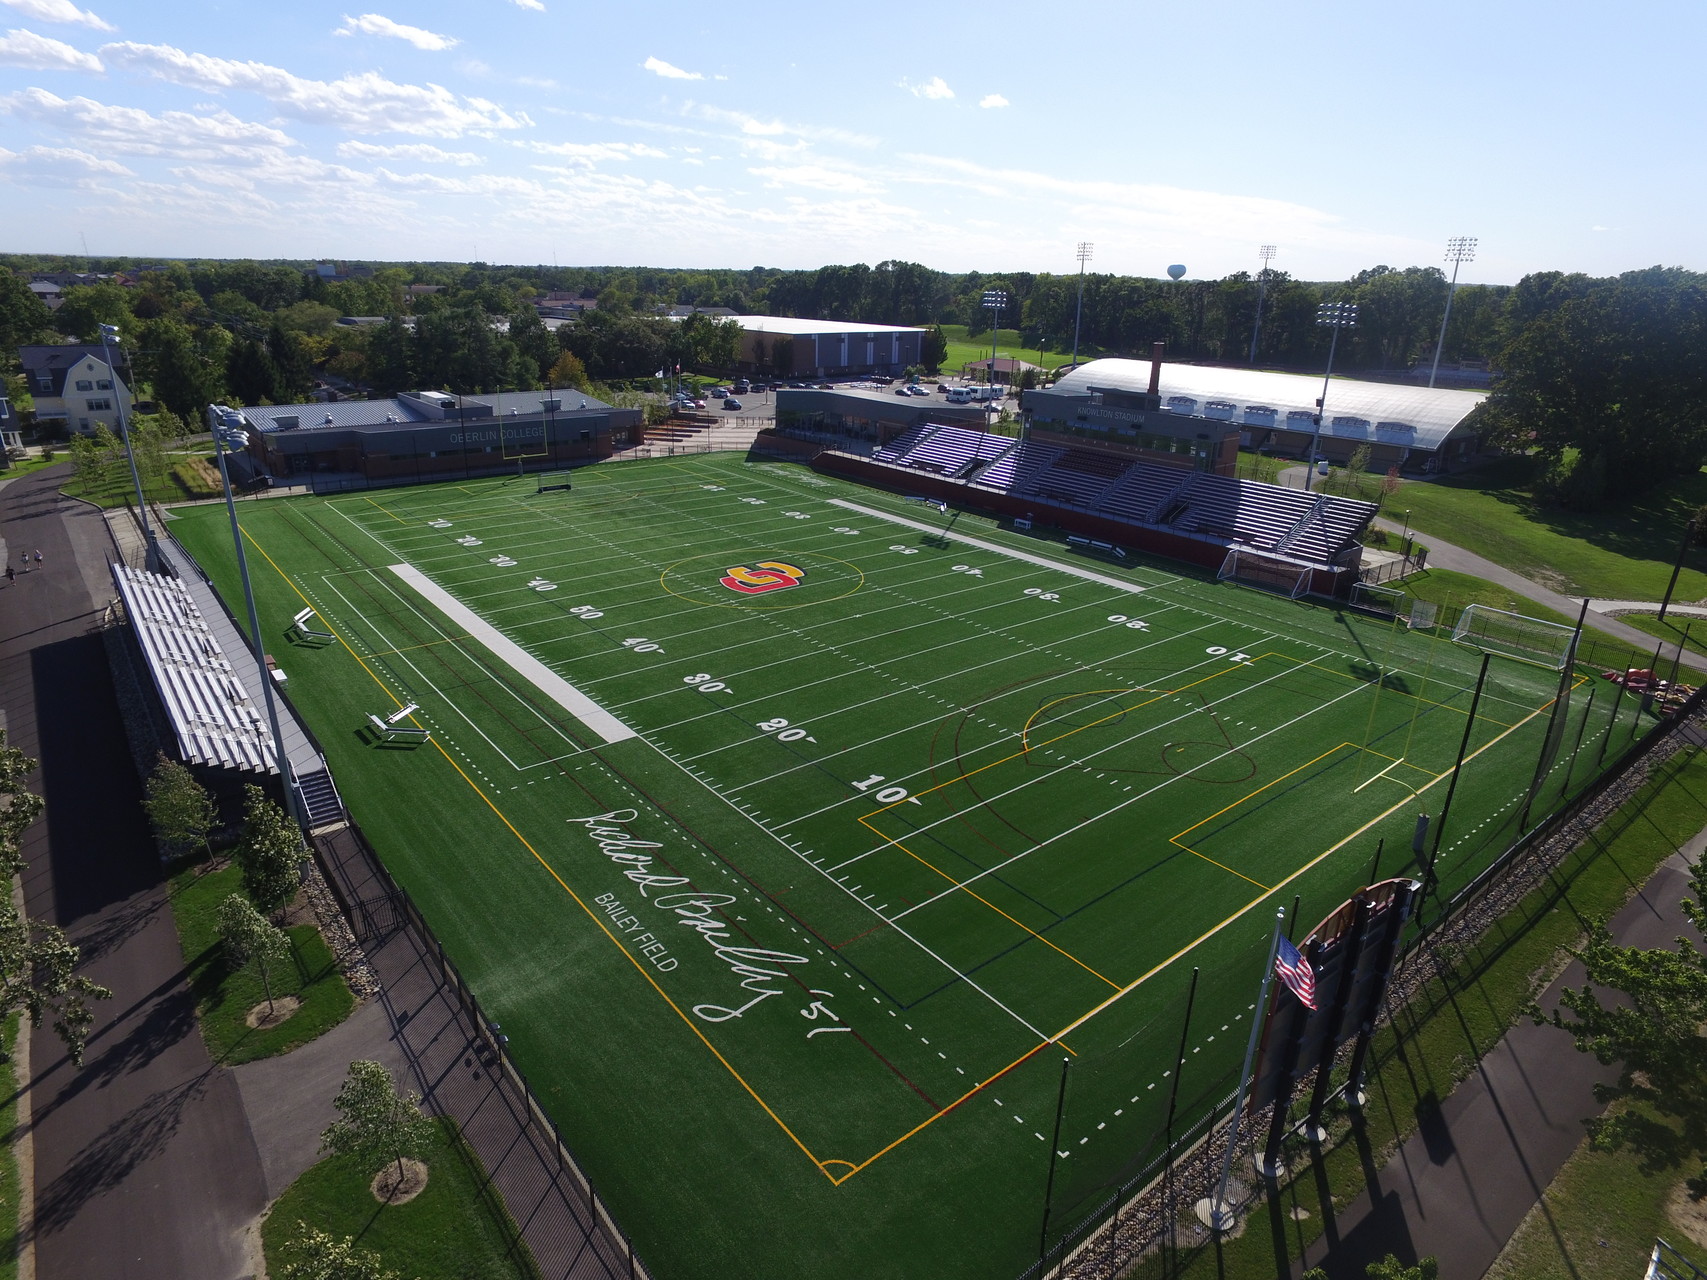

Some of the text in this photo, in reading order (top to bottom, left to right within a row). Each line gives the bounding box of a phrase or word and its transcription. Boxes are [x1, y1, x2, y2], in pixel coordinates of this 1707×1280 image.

[1078, 407, 1145, 423] KNOWLTON STADIUM
[450, 427, 544, 443] OBERLIN COLLEGE
[889, 545, 918, 554] 50
[951, 565, 983, 575] 40
[527, 580, 557, 591] 40
[1023, 588, 1059, 600] 30
[570, 605, 604, 620] 50
[1107, 615, 1149, 629] 20
[622, 637, 659, 653] 40
[1206, 646, 1250, 662] 10
[683, 673, 725, 693] 30
[756, 718, 807, 742] 20
[851, 774, 908, 803] 10
[594, 892, 679, 972] BAILEY FIELD
